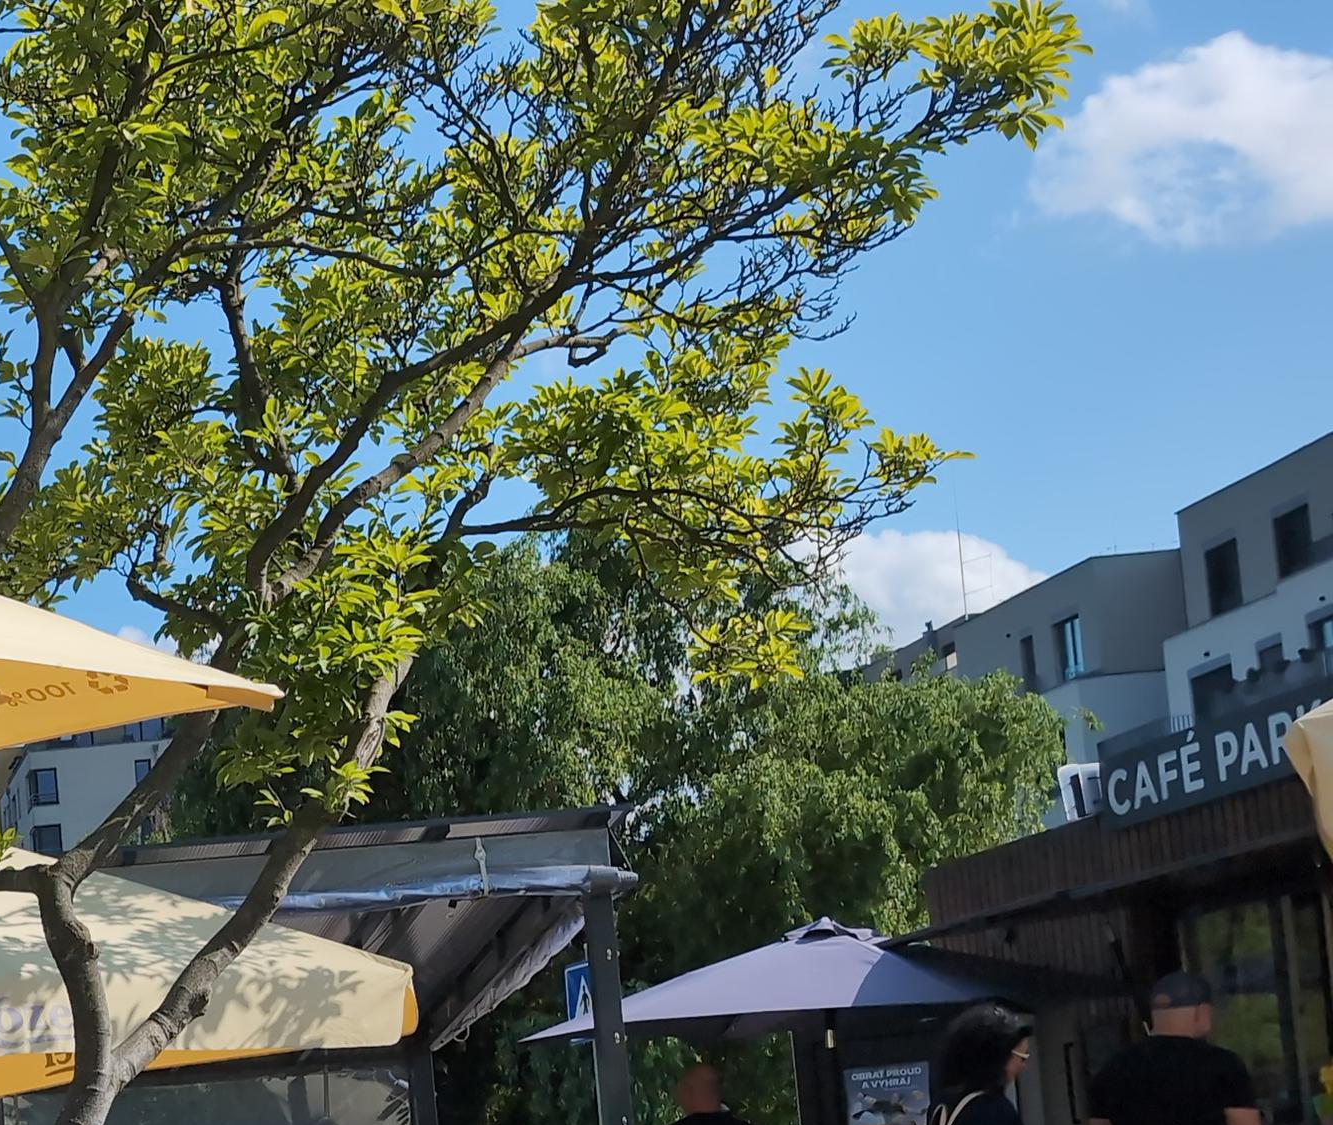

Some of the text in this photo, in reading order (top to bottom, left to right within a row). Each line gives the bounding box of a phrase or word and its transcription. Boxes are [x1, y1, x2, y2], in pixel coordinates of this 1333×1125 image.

[1108, 699, 1321, 816] CAFÉ PAR
[886, 1066, 922, 1078] PROUD
[862, 1082, 870, 1090] A
